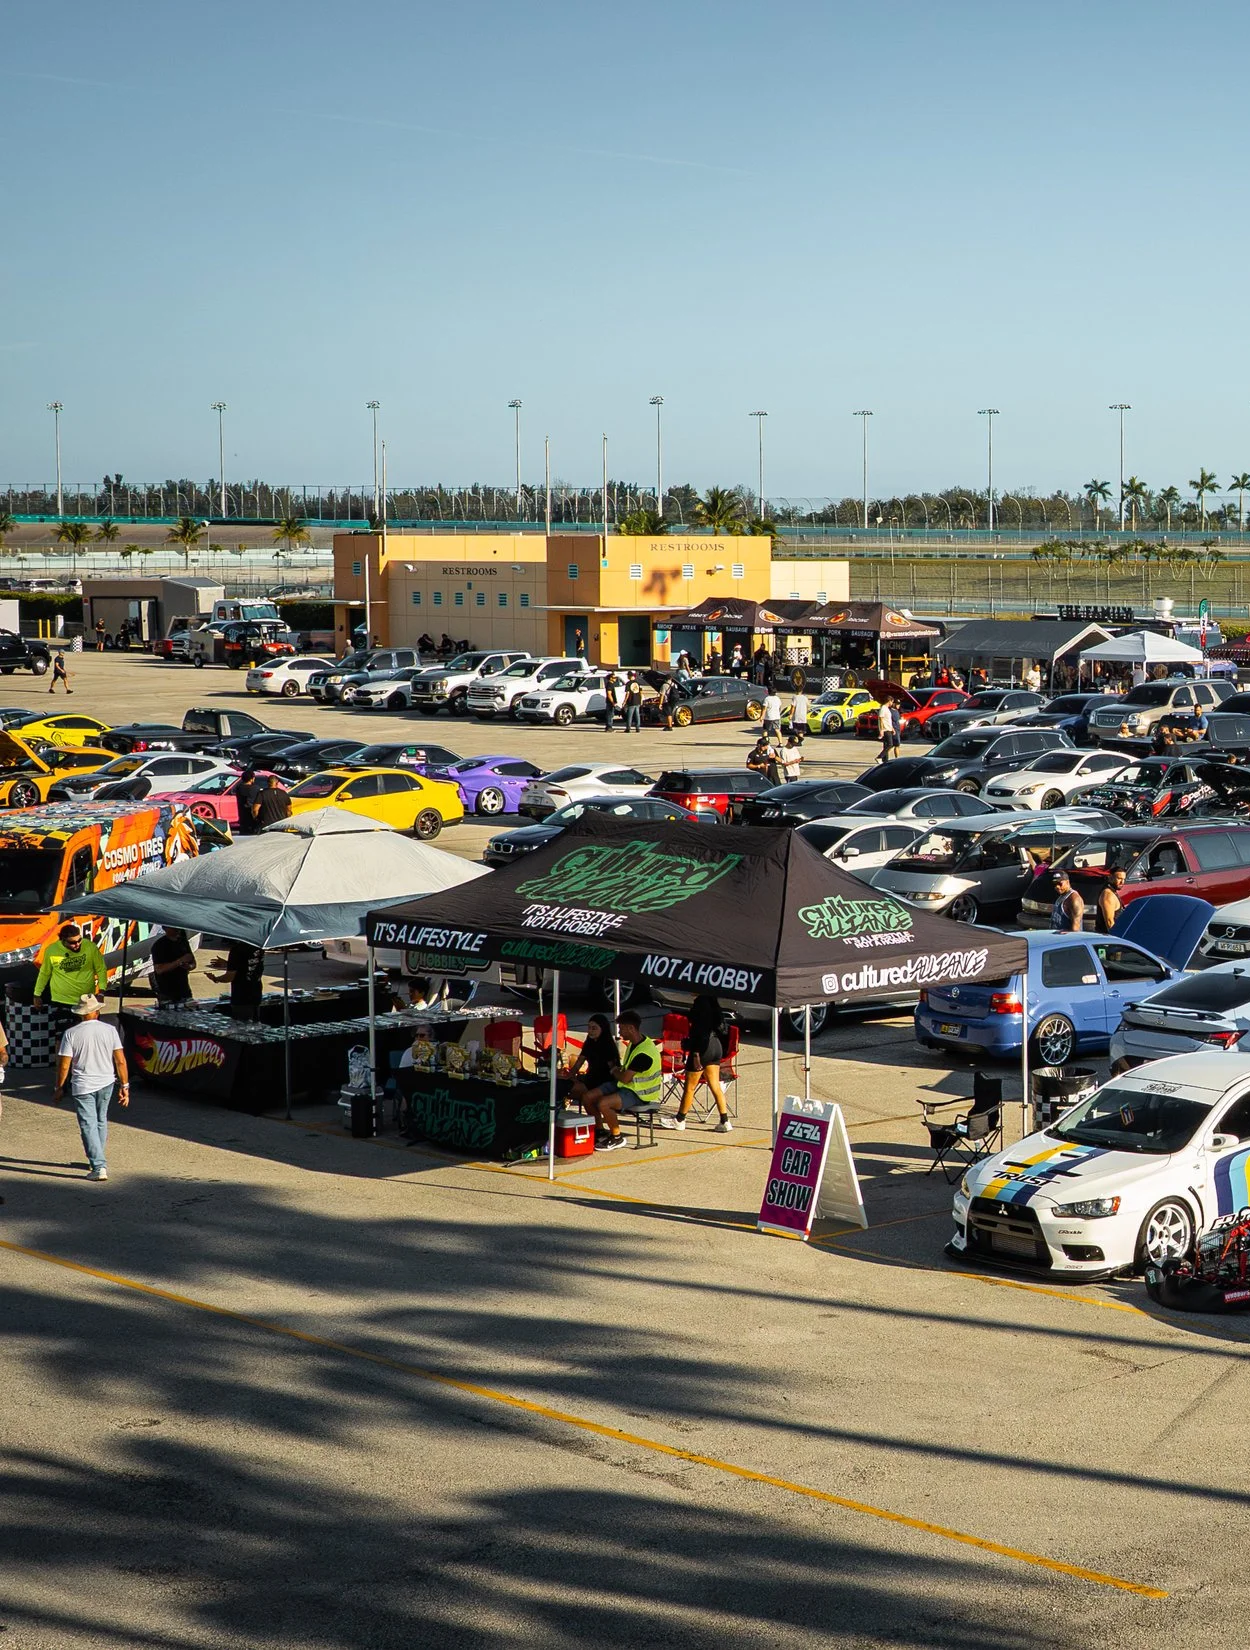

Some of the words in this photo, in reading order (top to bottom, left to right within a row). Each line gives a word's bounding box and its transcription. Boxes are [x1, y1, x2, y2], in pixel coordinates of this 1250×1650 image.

[650, 543, 725, 552] RESTROOMS
[442, 567, 498, 576] RESTROOMS
[851, 630, 874, 638] SAUSAGE
[846, 709, 854, 718] 17
[104, 844, 138, 871] COSMO
[139, 836, 164, 860] TIRES
[521, 915, 555, 929] NOT
[547, 919, 562, 930] A
[559, 919, 611, 937] HOBBY.
[522, 904, 550, 916] IT'S
[544, 906, 560, 918] A
[558, 907, 628, 928] LIFESTYLE,
[374, 922, 397, 942] IT'S
[396, 924, 408, 943] A
[408, 926, 488, 952] LIFESTYLE
[640, 955, 683, 977] NOT
[679, 961, 694, 982] A
[695, 963, 763, 993] HOBBY
[781, 1147, 812, 1178] CAR
[992, 1170, 1061, 1186] TRUST
[766, 1178, 813, 1212] SHOW
